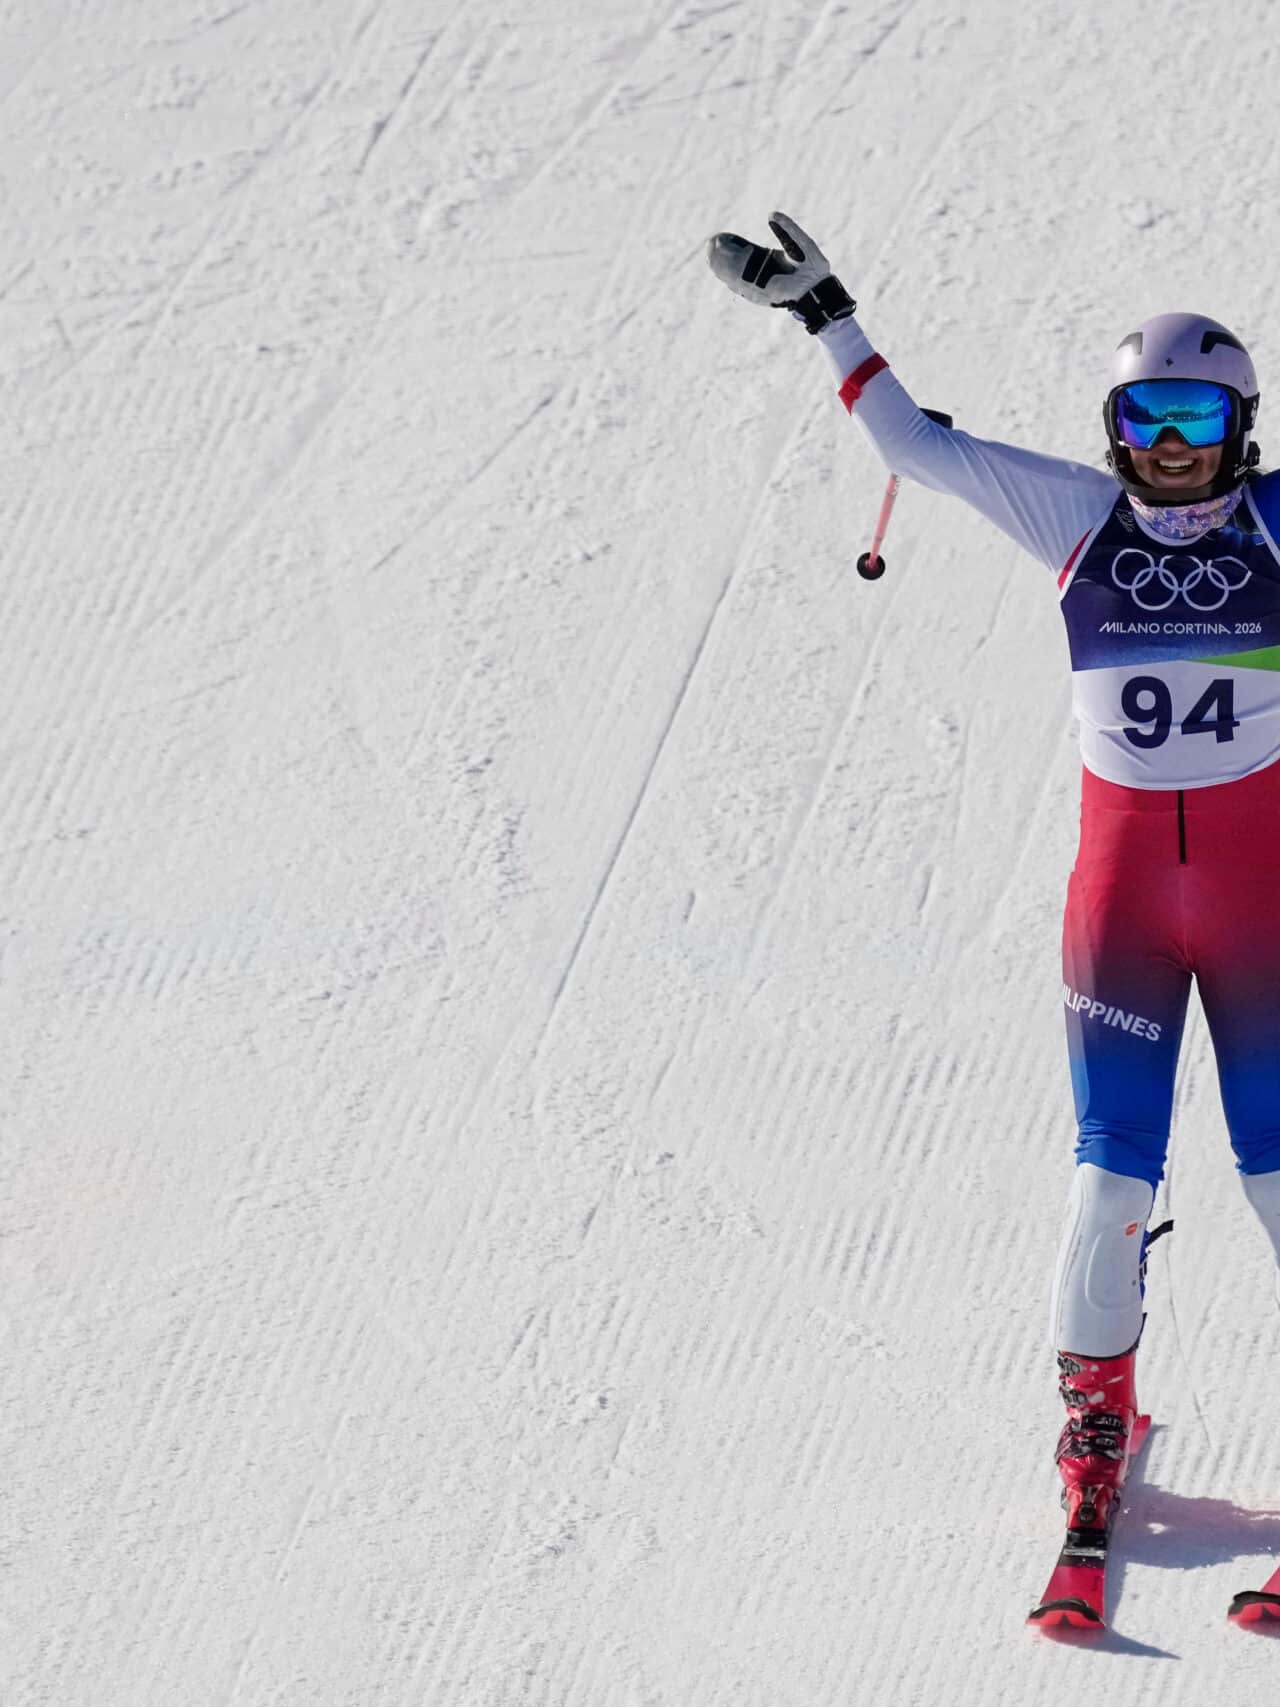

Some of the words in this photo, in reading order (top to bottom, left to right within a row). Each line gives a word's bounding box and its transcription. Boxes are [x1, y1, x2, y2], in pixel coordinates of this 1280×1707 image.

[1099, 621, 1160, 635] MILANO
[1163, 622, 1231, 635] CORTINA
[1234, 622, 1262, 635] 2026
[1121, 676, 1240, 749] 94
